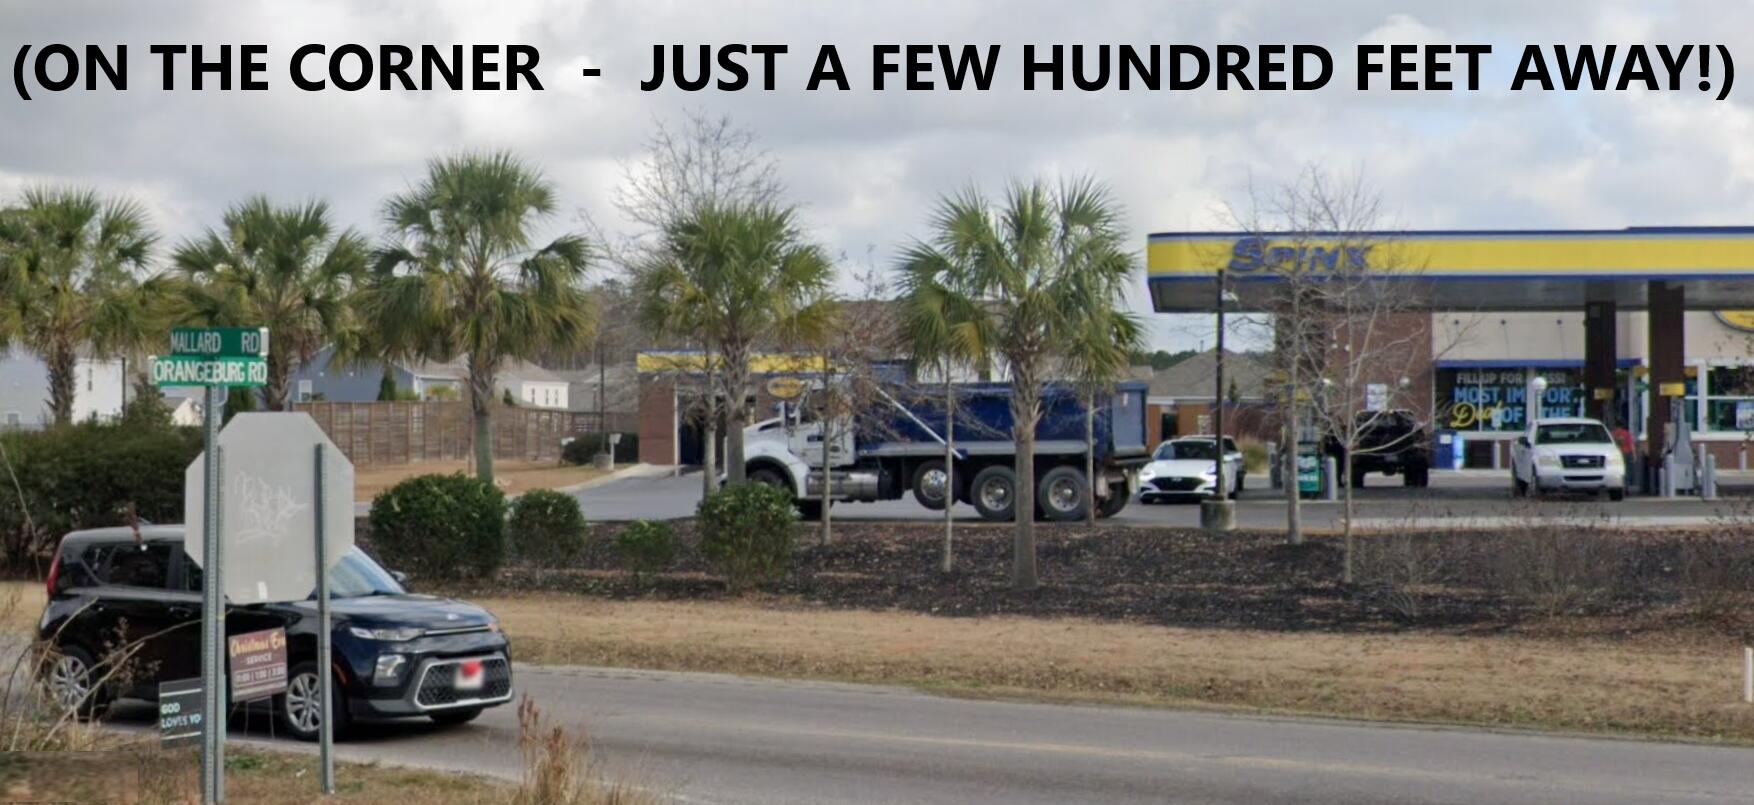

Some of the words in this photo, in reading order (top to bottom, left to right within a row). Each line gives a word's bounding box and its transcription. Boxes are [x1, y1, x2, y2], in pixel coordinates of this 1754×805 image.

[171, 332, 221, 353] MALLARD
[241, 332, 259, 353] RD
[153, 360, 245, 382] ORANGEBURG
[248, 361, 267, 384] RD
[1500, 373, 1522, 384] FOR
[1454, 386, 1500, 403] MOST
[1502, 406, 1524, 424] OF
[160, 702, 181, 715] GOD
[161, 715, 189, 729] LOVES
